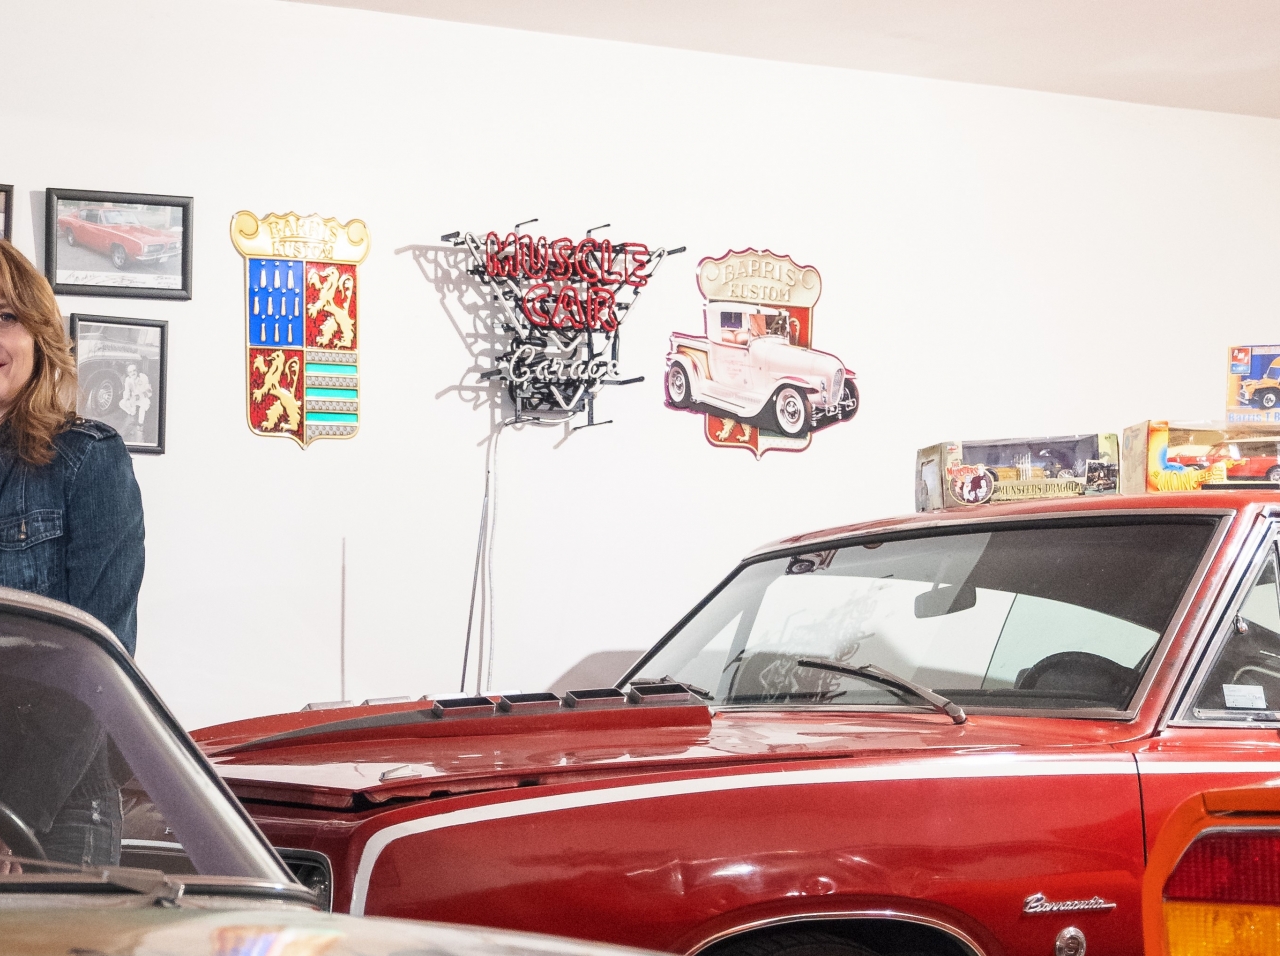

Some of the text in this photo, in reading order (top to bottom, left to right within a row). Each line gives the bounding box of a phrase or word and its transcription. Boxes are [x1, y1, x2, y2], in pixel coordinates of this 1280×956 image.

[267, 218, 339, 244] BARRIS
[271, 240, 334, 260] KUSTOM
[485, 231, 650, 288] MUSCLE
[729, 282, 792, 303] KUSTOM
[523, 283, 618, 332] CAR
[509, 344, 621, 393] Garage
[1228, 411, 1262, 423] Barris
[1264, 411, 1271, 422] T
[999, 484, 1042, 495] MUNSTERS
[1023, 892, 1117, 913] Barracuda
